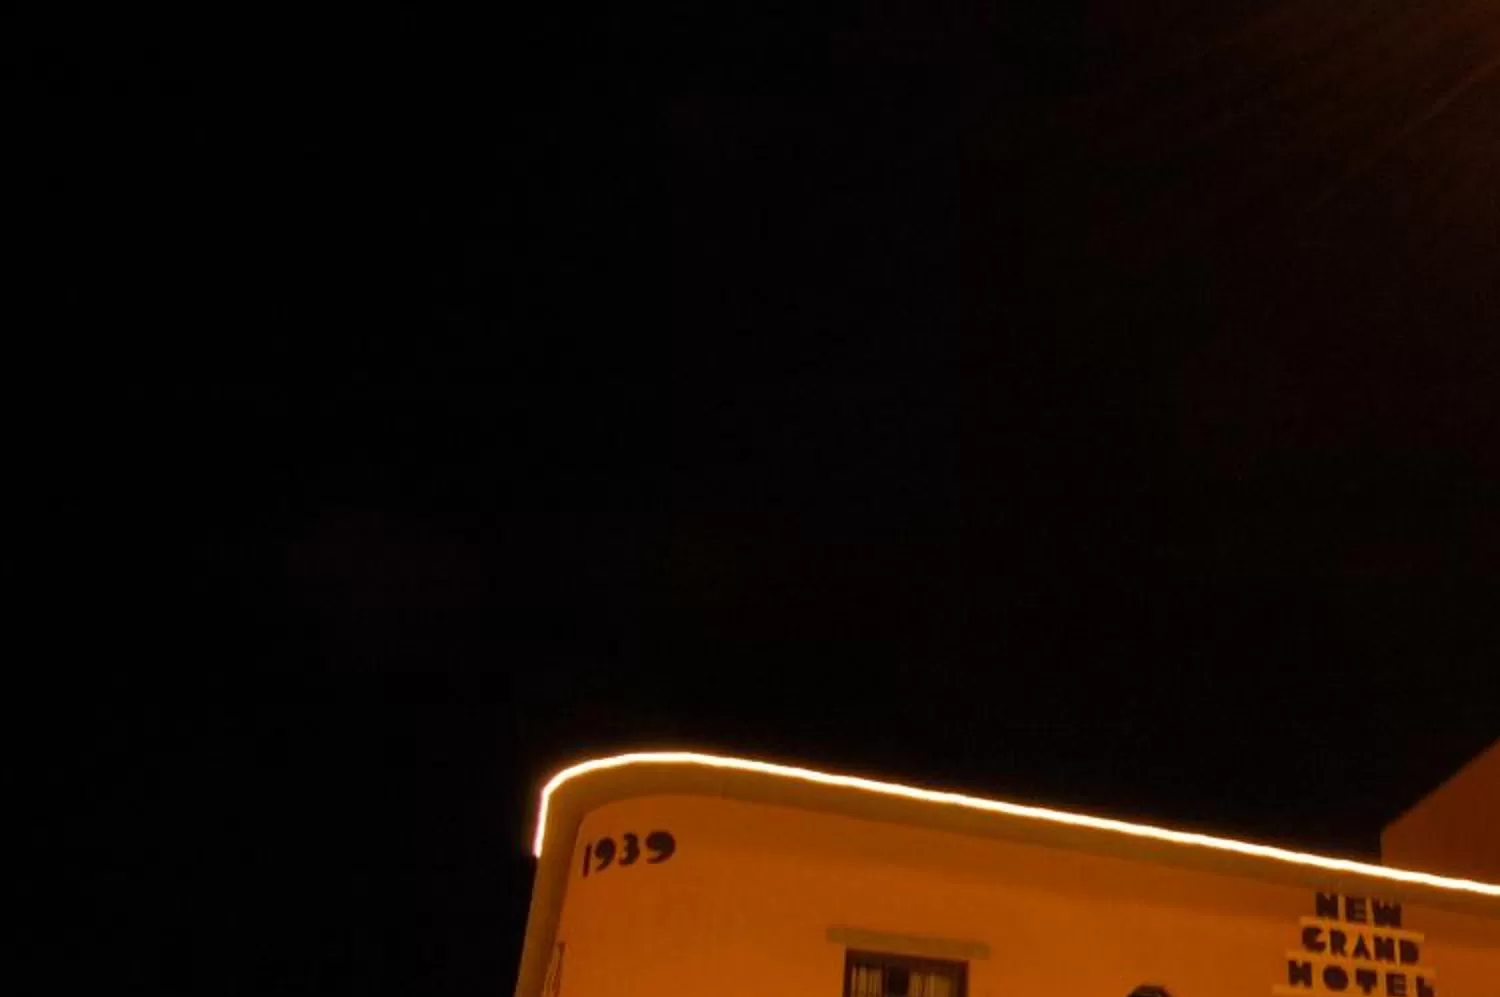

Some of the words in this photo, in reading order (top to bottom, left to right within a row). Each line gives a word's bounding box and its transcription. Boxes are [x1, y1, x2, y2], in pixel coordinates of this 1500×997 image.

[582, 831, 676, 878] 1939
[1315, 891, 1402, 929] NEW
[1301, 925, 1420, 965] GRAND
